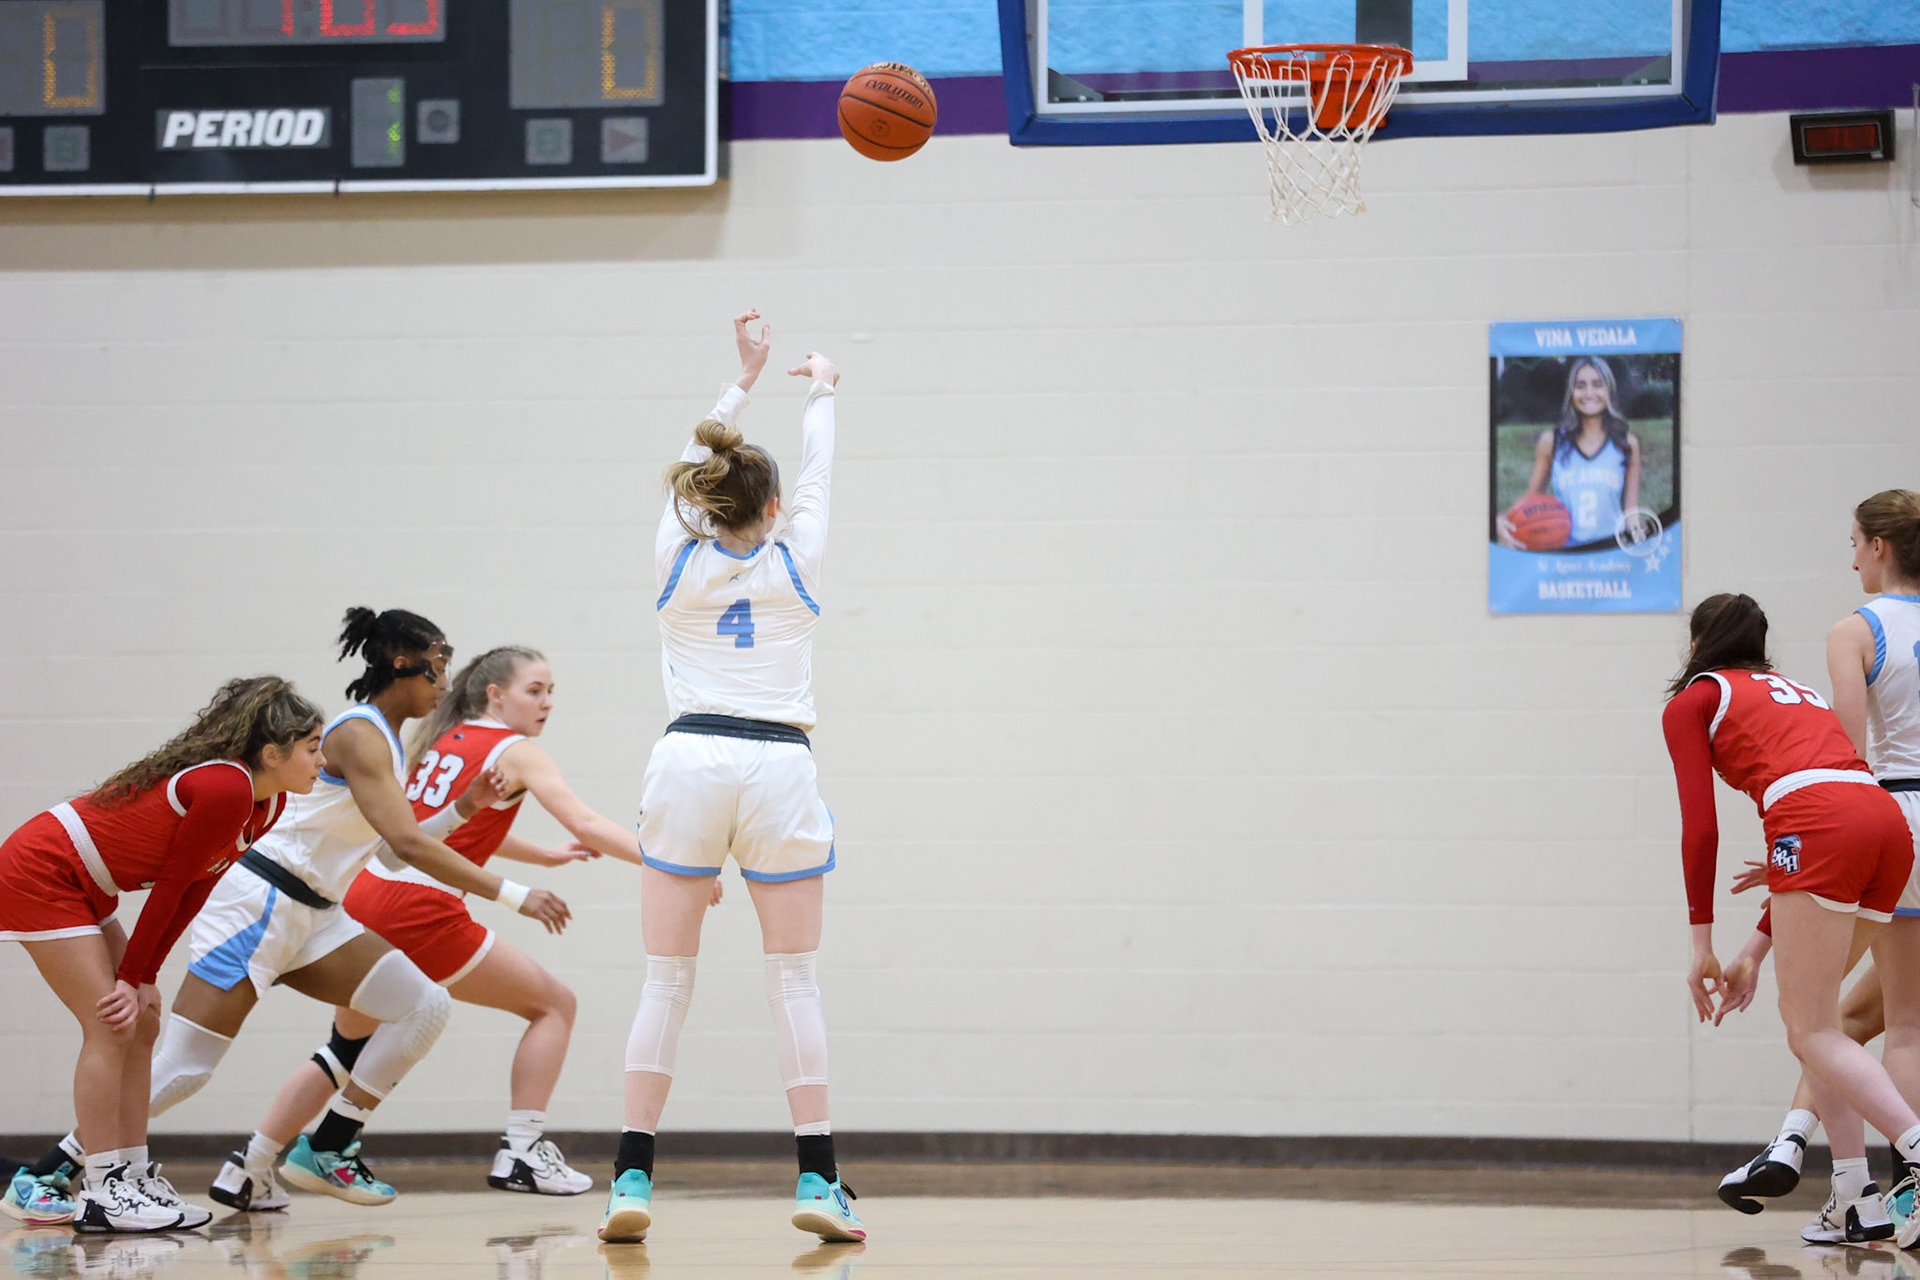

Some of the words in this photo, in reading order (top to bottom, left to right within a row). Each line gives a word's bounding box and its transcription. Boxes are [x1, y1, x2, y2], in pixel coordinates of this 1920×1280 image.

[865, 79, 924, 109] EVOLUTION
[162, 108, 326, 149] PERIOD
[1534, 327, 1573, 348] VINA
[1576, 325, 1637, 347] VEDALA
[1578, 490, 1598, 528] 2
[1538, 579, 1633, 599] BASKETBALL
[716, 598, 755, 648] 4
[405, 749, 466, 809] 33
[1771, 846, 1799, 874] SBA
